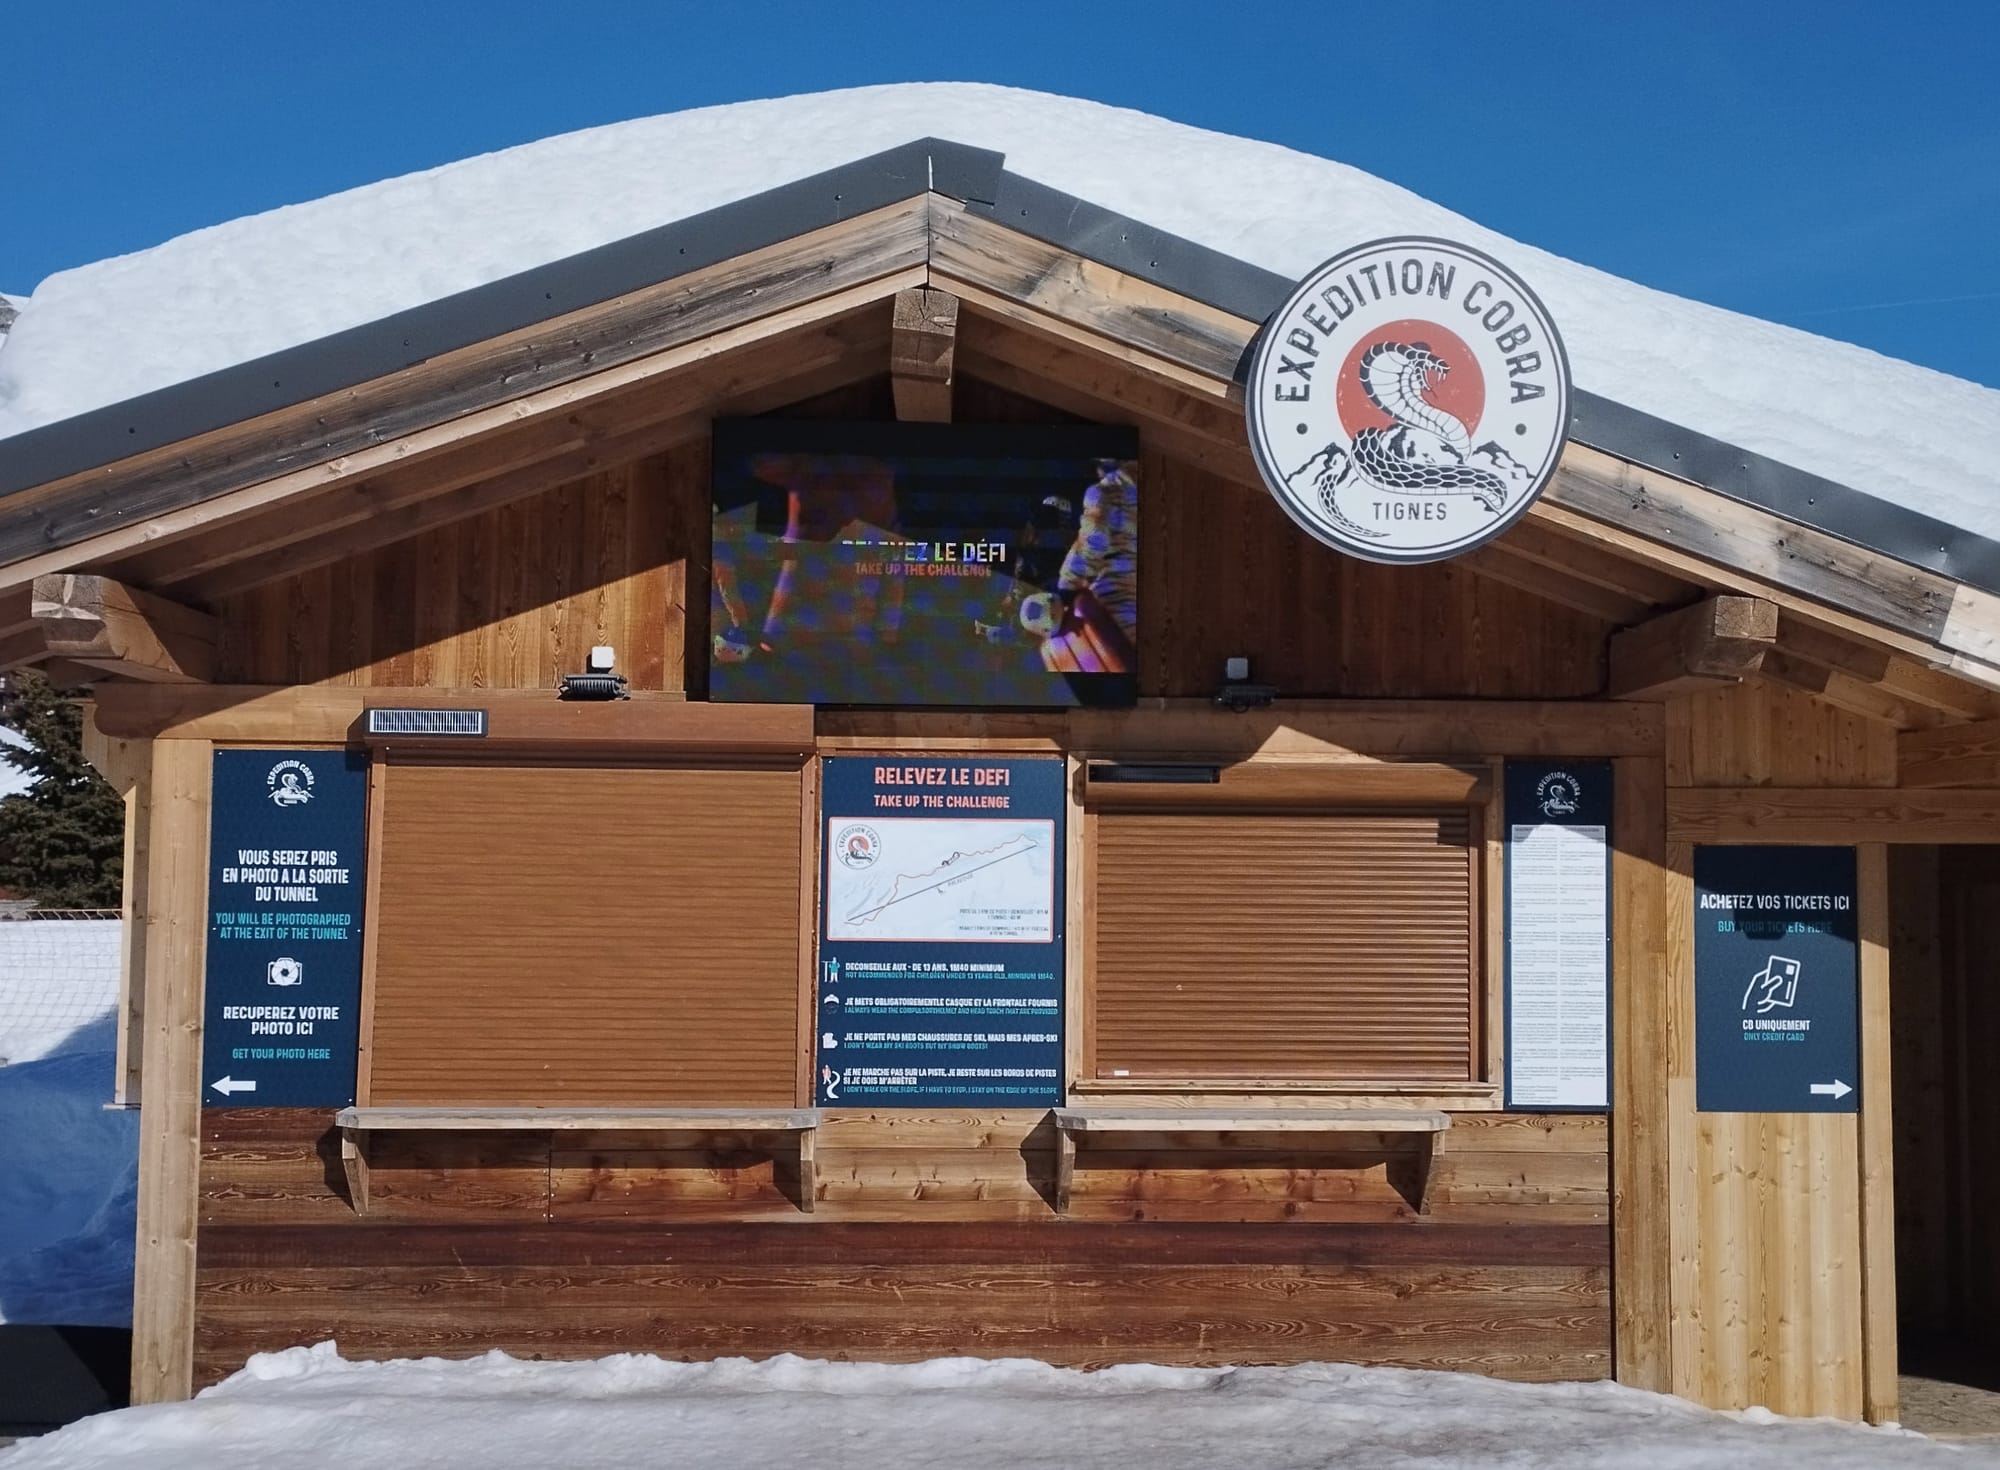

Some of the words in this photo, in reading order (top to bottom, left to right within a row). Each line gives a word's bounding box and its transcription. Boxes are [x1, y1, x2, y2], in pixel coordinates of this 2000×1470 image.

[1275, 258, 1457, 402] EXPEDITION
[1462, 280, 1546, 404] COBRA
[1372, 502, 1447, 520] TIGNES
[934, 542, 957, 561] LE
[963, 538, 1006, 562] DÉFI
[855, 562, 884, 576] TAKE
[886, 562, 901, 576] UP
[904, 563, 925, 577] THE
[874, 767, 946, 785] RELEVEZ
[950, 768, 970, 786] LE
[974, 768, 1010, 786] DEFI
[874, 795, 902, 807] TAKE
[905, 795, 920, 807] UP
[924, 796, 944, 808] THE
[946, 796, 1010, 808] CHALLENGE
[238, 850, 269, 865] VOUS
[272, 851, 308, 865] SEREZ
[311, 851, 337, 865] PRIS
[223, 868, 238, 883] EN
[241, 868, 277, 883] PHOTO
[282, 869, 290, 883] A
[292, 869, 306, 883] LA
[309, 869, 349, 884] SORTIE
[256, 887, 271, 901] DU
[274, 887, 318, 901] TUNNEL
[1700, 894, 1753, 909] ACHETEZ
[1756, 894, 1781, 909] VOS
[1784, 895, 1831, 909] TICKETS
[1834, 895, 1850, 910] ICI
[216, 913, 234, 924] YOU
[238, 913, 259, 924] WILL
[262, 913, 274, 924] BE
[276, 914, 350, 925] PHOTOGRAPHED
[1718, 921, 1736, 932] BUY
[220, 928, 231, 939] AT
[234, 928, 252, 939] THE
[254, 928, 274, 939] EXIT
[276, 928, 289, 939] OF
[292, 928, 308, 939] THE
[312, 928, 348, 939] TUNNEL
[224, 1007, 296, 1019] RECUPEREZ
[299, 1007, 340, 1019] VOTRE
[252, 1022, 293, 1035] PHOTO
[296, 1022, 313, 1035] ICI
[1742, 1020, 1754, 1030] CB
[1755, 1020, 1810, 1030] UNIQUEMENT
[1744, 1033, 1760, 1041] ONLY
[1762, 1033, 1785, 1041] CREDIT
[1786, 1033, 1804, 1041] CARD
[232, 1049, 248, 1059] GET
[251, 1049, 274, 1059] YOUR
[277, 1049, 305, 1059] PHOTO
[307, 1049, 330, 1059] HERE
